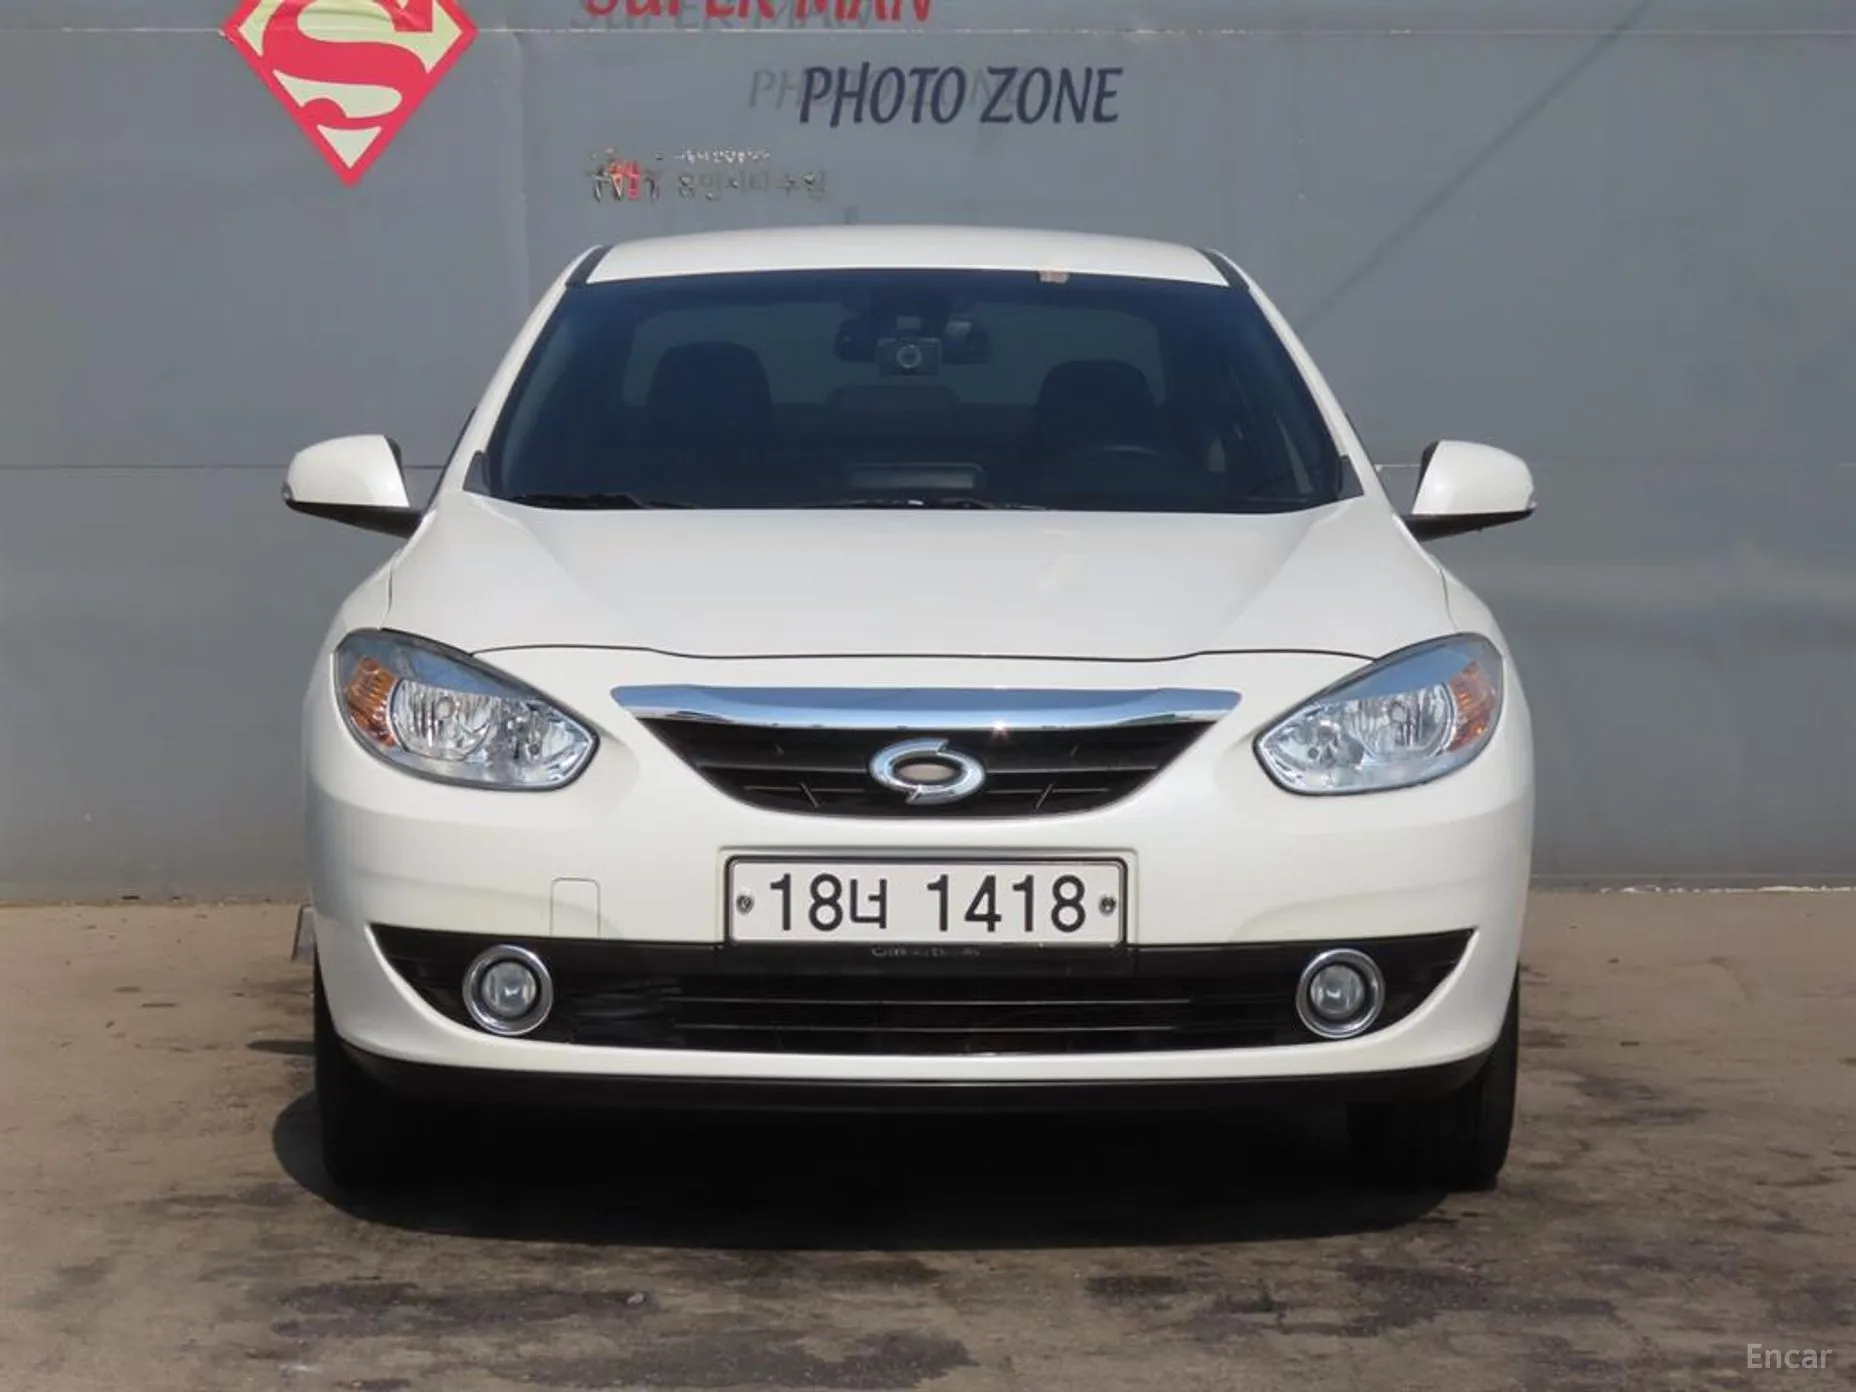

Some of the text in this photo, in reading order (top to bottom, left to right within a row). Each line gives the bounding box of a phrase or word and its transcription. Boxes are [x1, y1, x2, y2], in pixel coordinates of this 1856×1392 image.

[799, 61, 1125, 128] PHOTO ZONE
[769, 873, 1087, 933] 18너 1418
